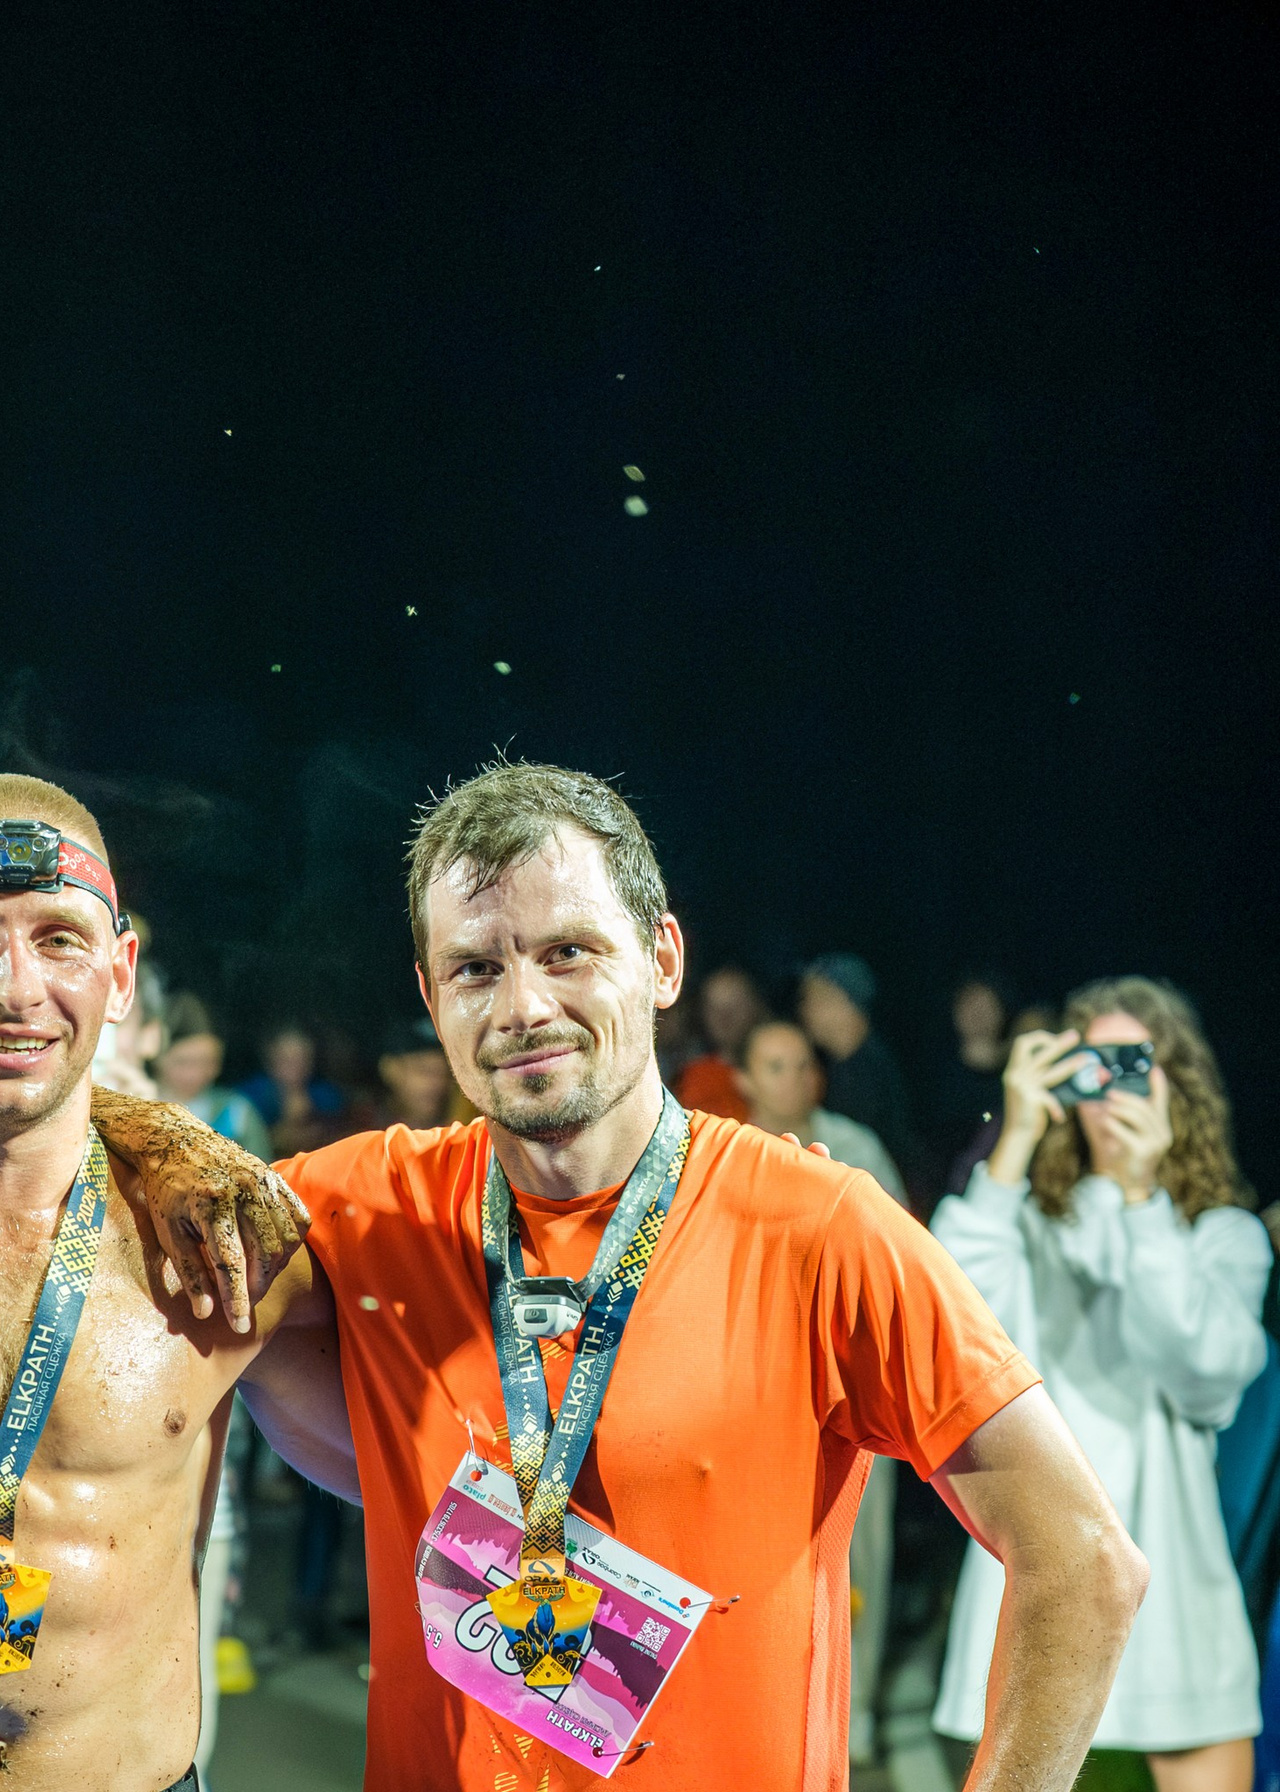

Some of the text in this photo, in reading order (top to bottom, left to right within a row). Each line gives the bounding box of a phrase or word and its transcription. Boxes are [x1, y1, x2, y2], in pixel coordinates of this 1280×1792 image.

[76, 1185, 98, 1227] 2026
[632, 1176, 650, 1205] VARTA
[596, 1242, 617, 1275] VARTA
[7, 1324, 56, 1431] ELKPATH
[558, 1325, 604, 1434] ELKPATH
[463, 1484, 487, 1501] plato
[523, 1586, 565, 1596] ELKPATH
[426, 1625, 443, 1649] 5.5
[546, 1711, 604, 1748] ELKPATH
